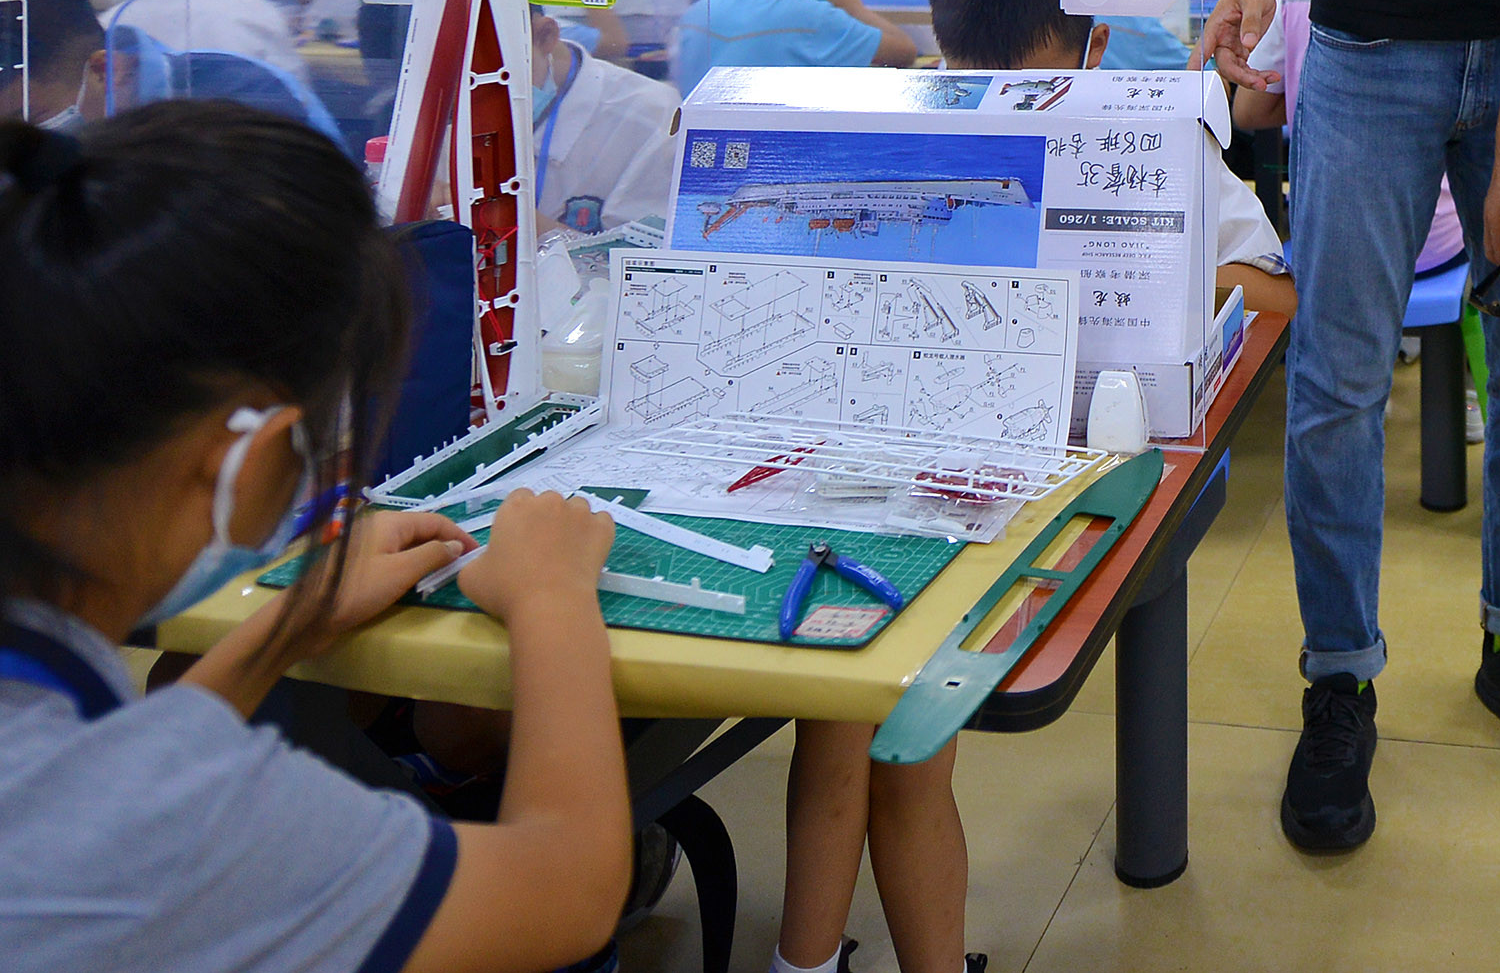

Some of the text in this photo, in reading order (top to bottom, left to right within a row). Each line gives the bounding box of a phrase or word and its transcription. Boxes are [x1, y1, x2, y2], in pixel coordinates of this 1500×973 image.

[1059, 214, 1175, 226] KIT SCALE: 1/260
[1093, 291, 1131, 306] 蛟龙
